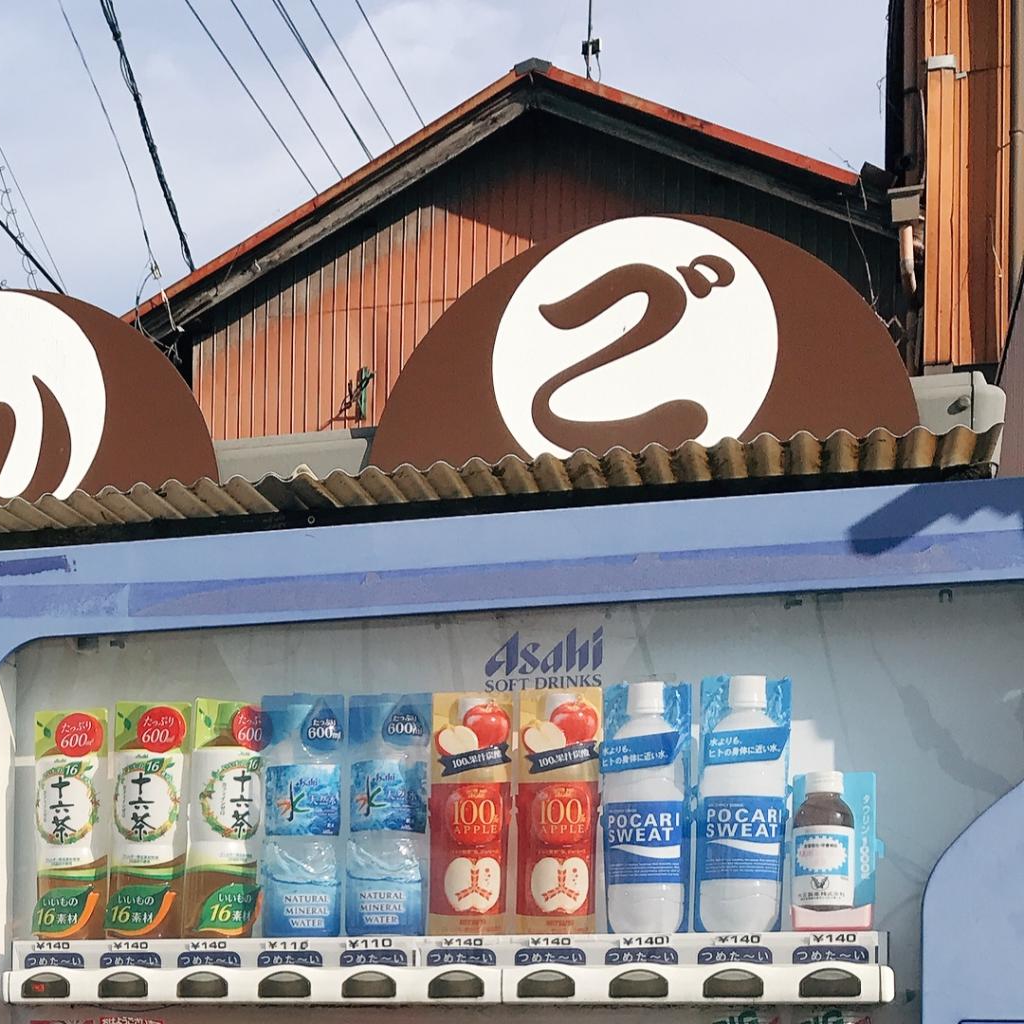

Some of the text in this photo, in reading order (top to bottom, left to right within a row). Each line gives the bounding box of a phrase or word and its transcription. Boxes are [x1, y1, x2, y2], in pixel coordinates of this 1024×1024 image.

[485, 625, 604, 677] Asahi
[485, 674, 602, 692] SOFT DRINKS
[49, 777, 76, 843] 十六茶
[129, 773, 156, 840] 十六茶
[230, 770, 253, 841] 十六茶
[608, 813, 680, 828] POCARI
[706, 809, 781, 824] POCARI
[454, 825, 497, 834] APPLE
[541, 825, 585, 834] APPLE
[706, 823, 778, 838] SWEAT
[608, 827, 673, 843] SWEAT
[42, 895, 79, 906] いいもの
[118, 895, 154, 906] いいもの
[284, 895, 329, 904] NATURAL
[359, 892, 404, 900] NATURAL
[285, 907, 329, 916] MINERAL
[360, 904, 404, 912] MINERAL
[290, 919, 324, 928] WATER
[364, 916, 398, 925] WATER
[348, 938, 393, 948] ¥110
[444, 938, 483, 947] ¥140
[531, 937, 571, 946] ¥140
[623, 936, 666, 946] ¥140
[718, 935, 761, 944] ¥140
[813, 934, 856, 943] ¥140
[35, 941, 70, 950] ¥140
[114, 941, 149, 950] ¥140
[191, 941, 227, 950] ¥140
[268, 940, 309, 950] ¥110
